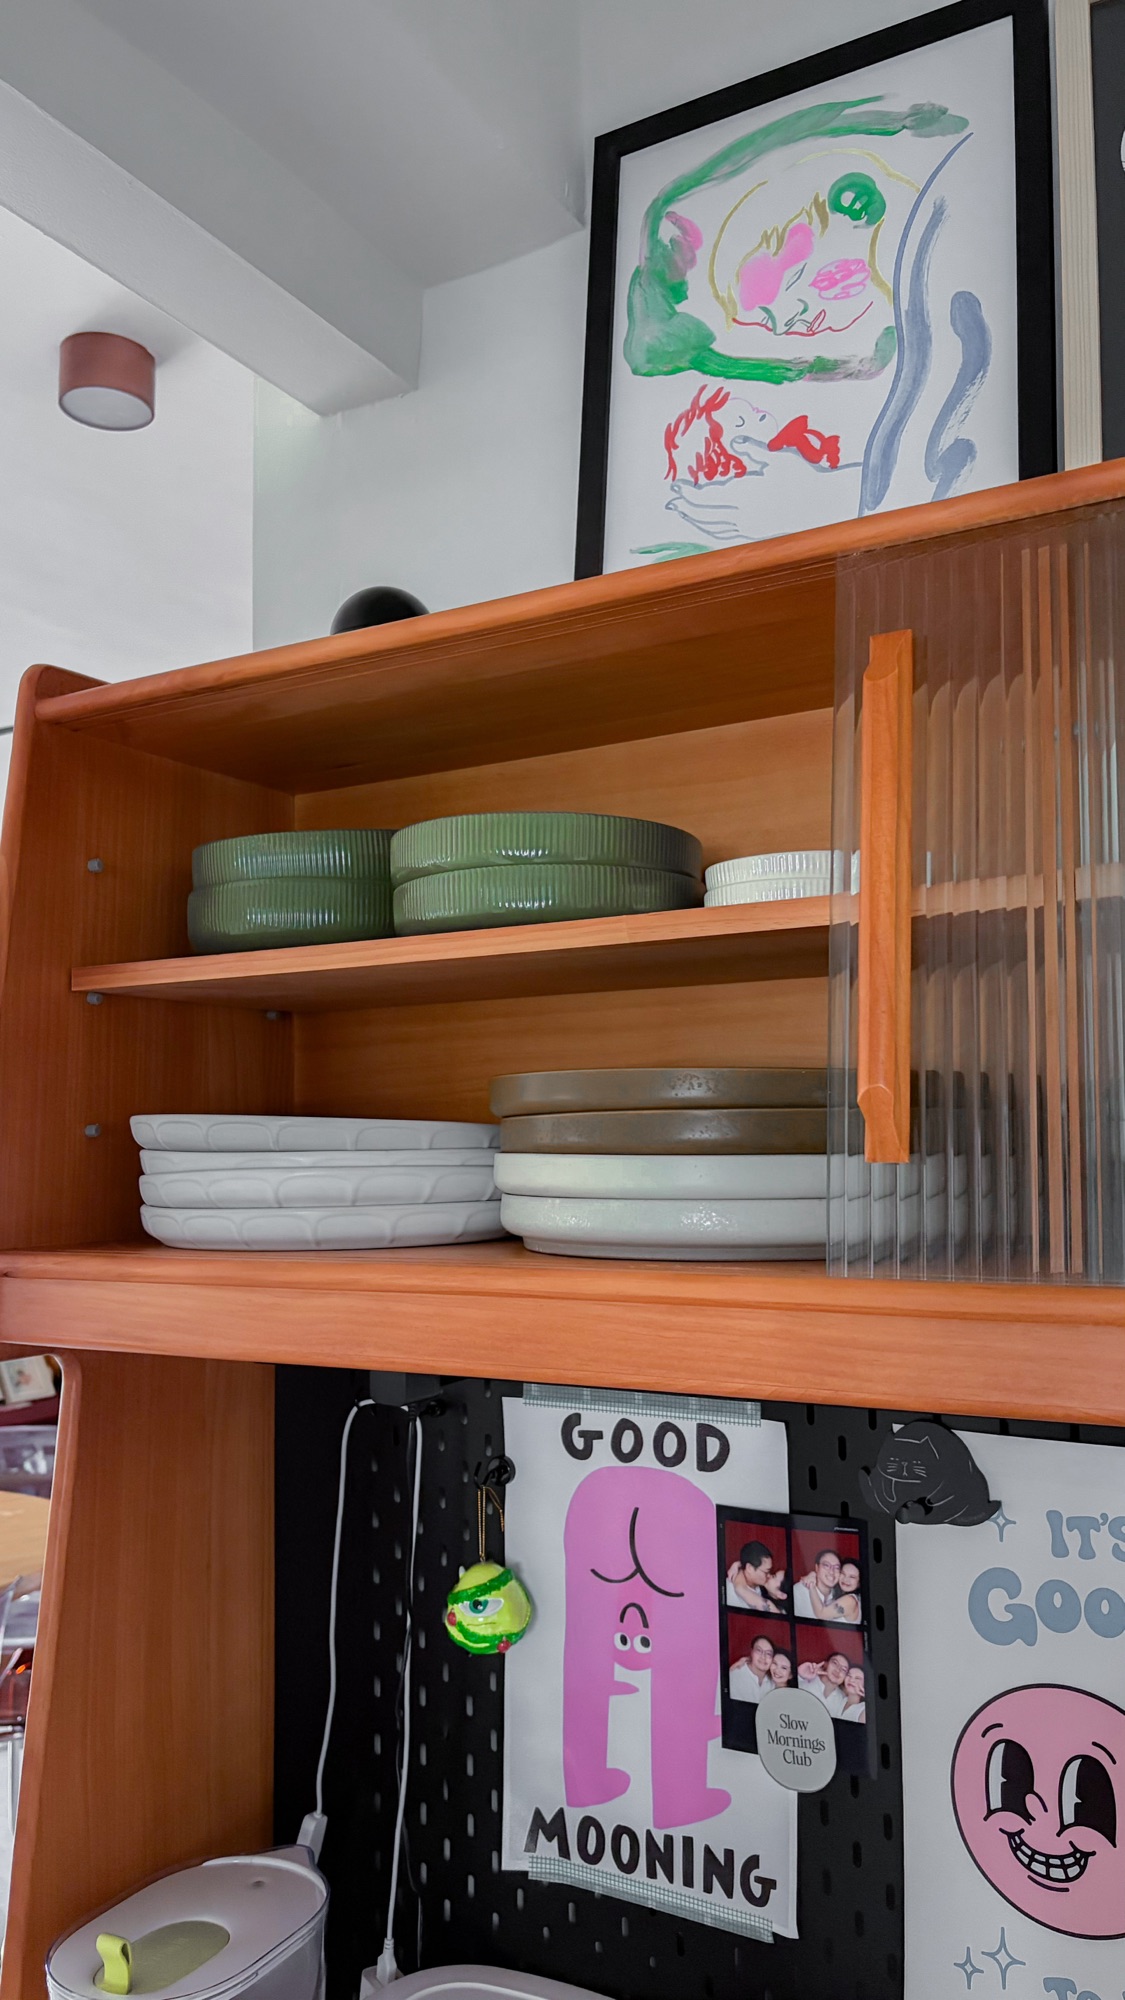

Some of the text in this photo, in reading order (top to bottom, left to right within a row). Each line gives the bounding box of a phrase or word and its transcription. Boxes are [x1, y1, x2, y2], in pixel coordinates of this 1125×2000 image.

[561, 1412, 731, 1473] GOOD
[779, 1713, 809, 1732] Slow
[767, 1729, 826, 1754] Mornings
[782, 1748, 812, 1767] Club
[523, 1806, 777, 1908] MOONING
